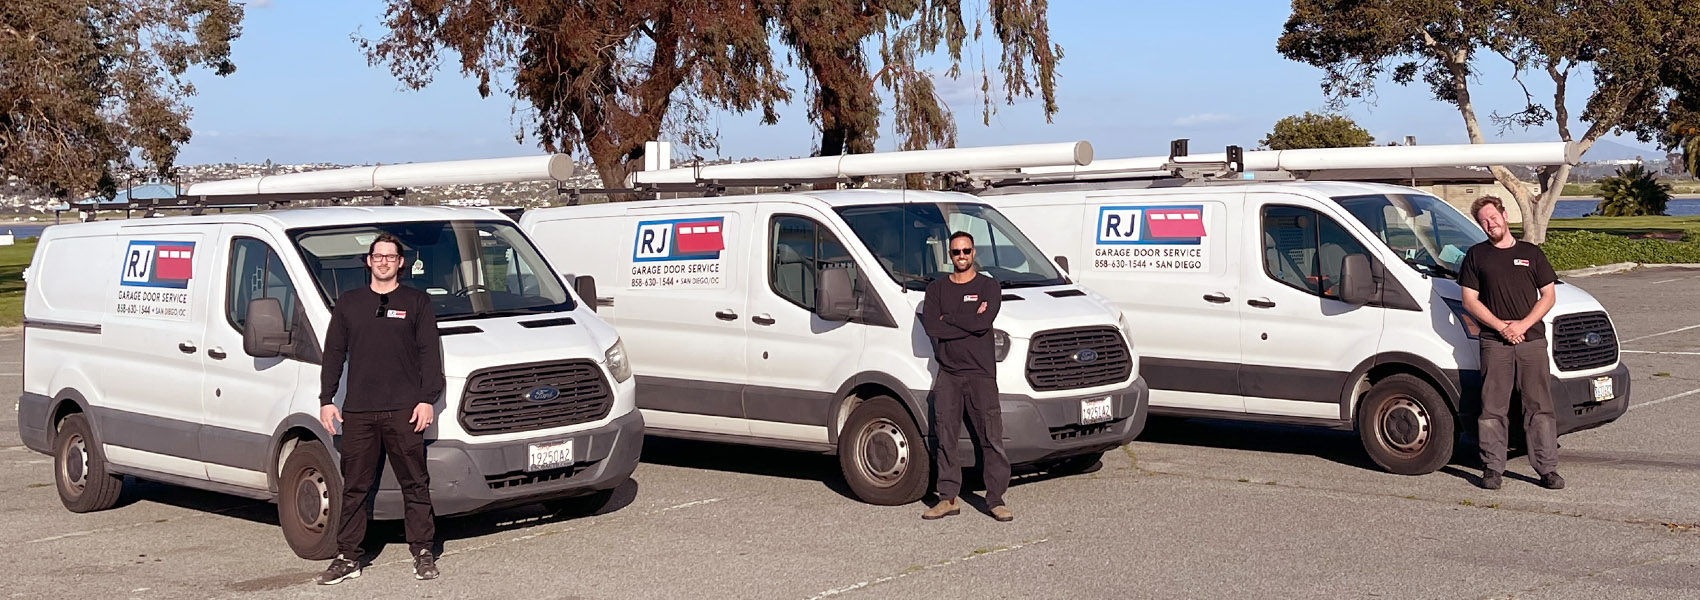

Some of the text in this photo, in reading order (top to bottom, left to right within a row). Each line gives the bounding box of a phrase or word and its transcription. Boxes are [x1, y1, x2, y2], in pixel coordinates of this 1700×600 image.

[1105, 214, 1135, 237] RJ
[641, 228, 667, 254] RJ
[1095, 248, 1202, 257] GARAGE DOOR SERVICE
[127, 250, 150, 278] RJ
[631, 263, 720, 275] GARAGE DOOR SERVICE
[1094, 259, 1202, 269] 858-630-1544 SAN DIEGO
[631, 276, 674, 287] 858-630-1544
[680, 277, 691, 285] SAN
[118, 291, 187, 304] GARAGE DOOR SERVICE
[117, 304, 151, 314] 858-630-1544
[155, 307, 164, 315] SAN
[534, 389, 554, 400] Ford
